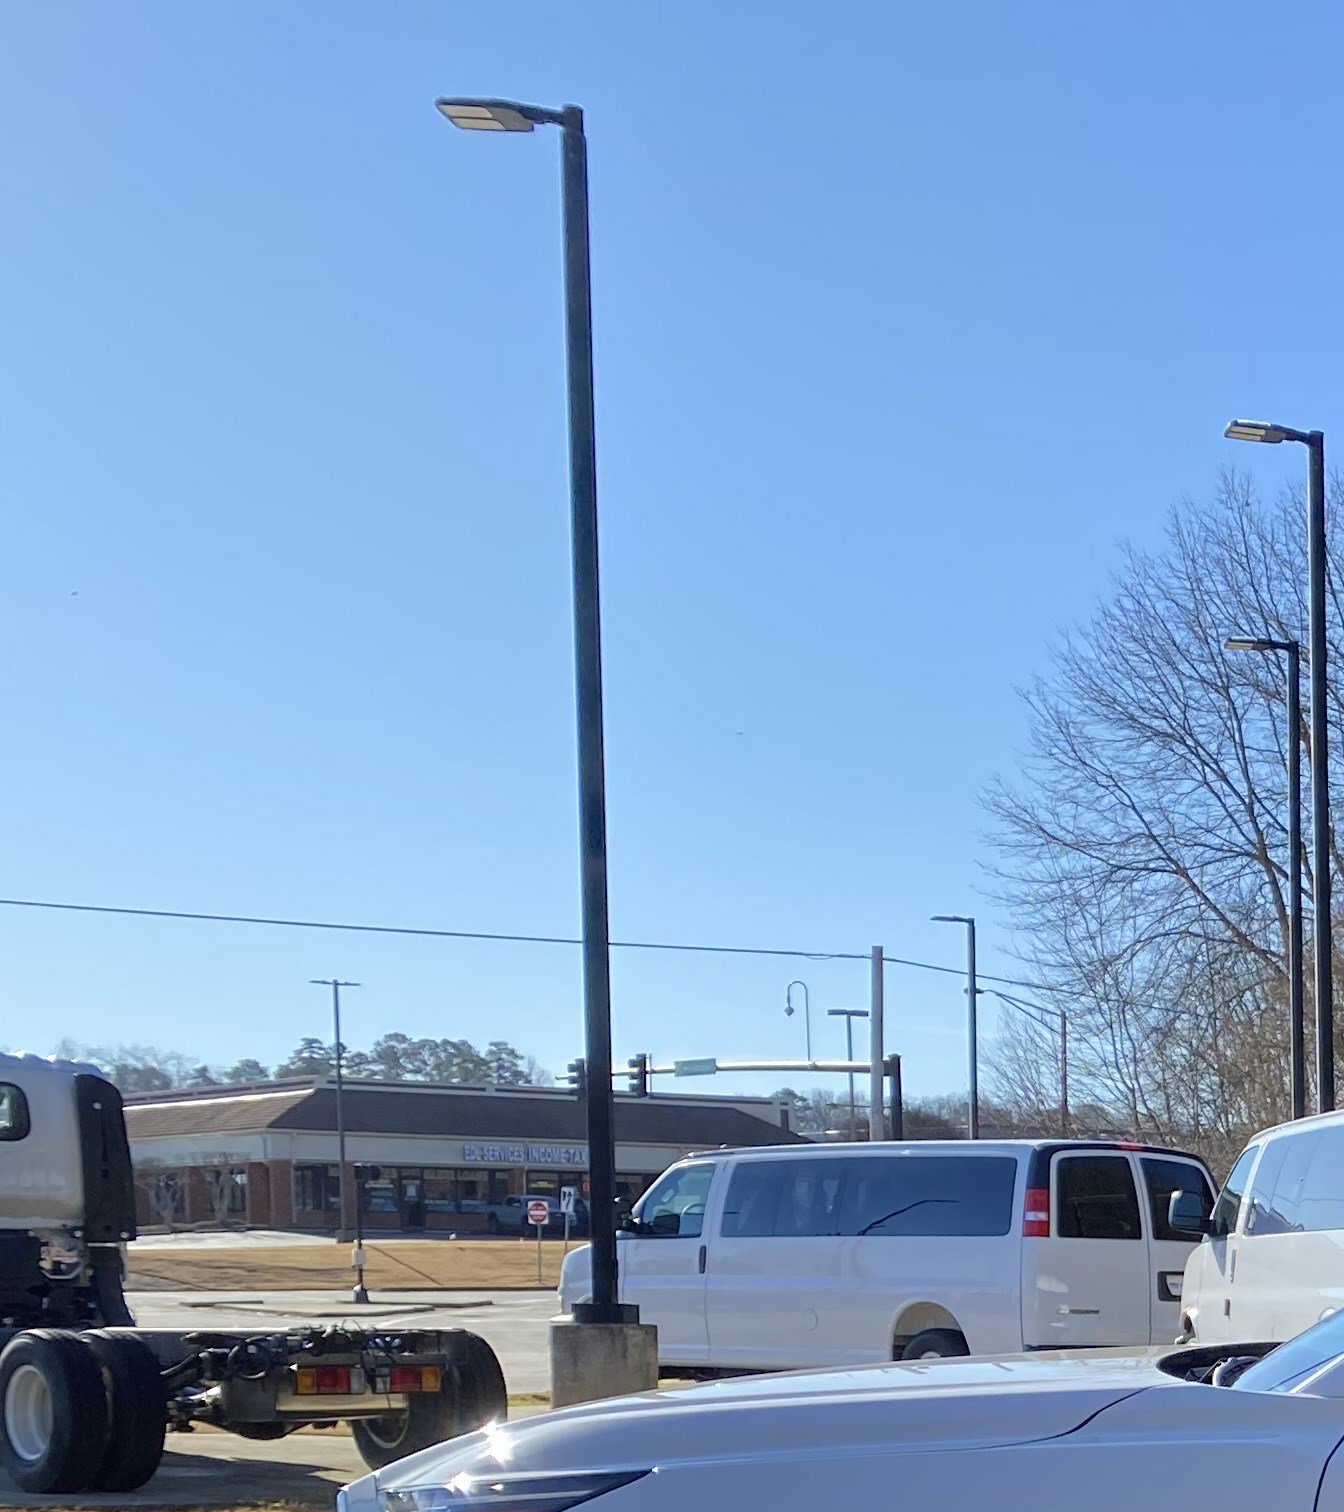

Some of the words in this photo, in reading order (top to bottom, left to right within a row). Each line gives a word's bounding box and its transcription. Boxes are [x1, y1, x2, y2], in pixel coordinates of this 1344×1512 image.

[482, 1145, 524, 1161] SERVICES
[527, 1147, 566, 1162] INCOME
[567, 1149, 586, 1163] TAX
